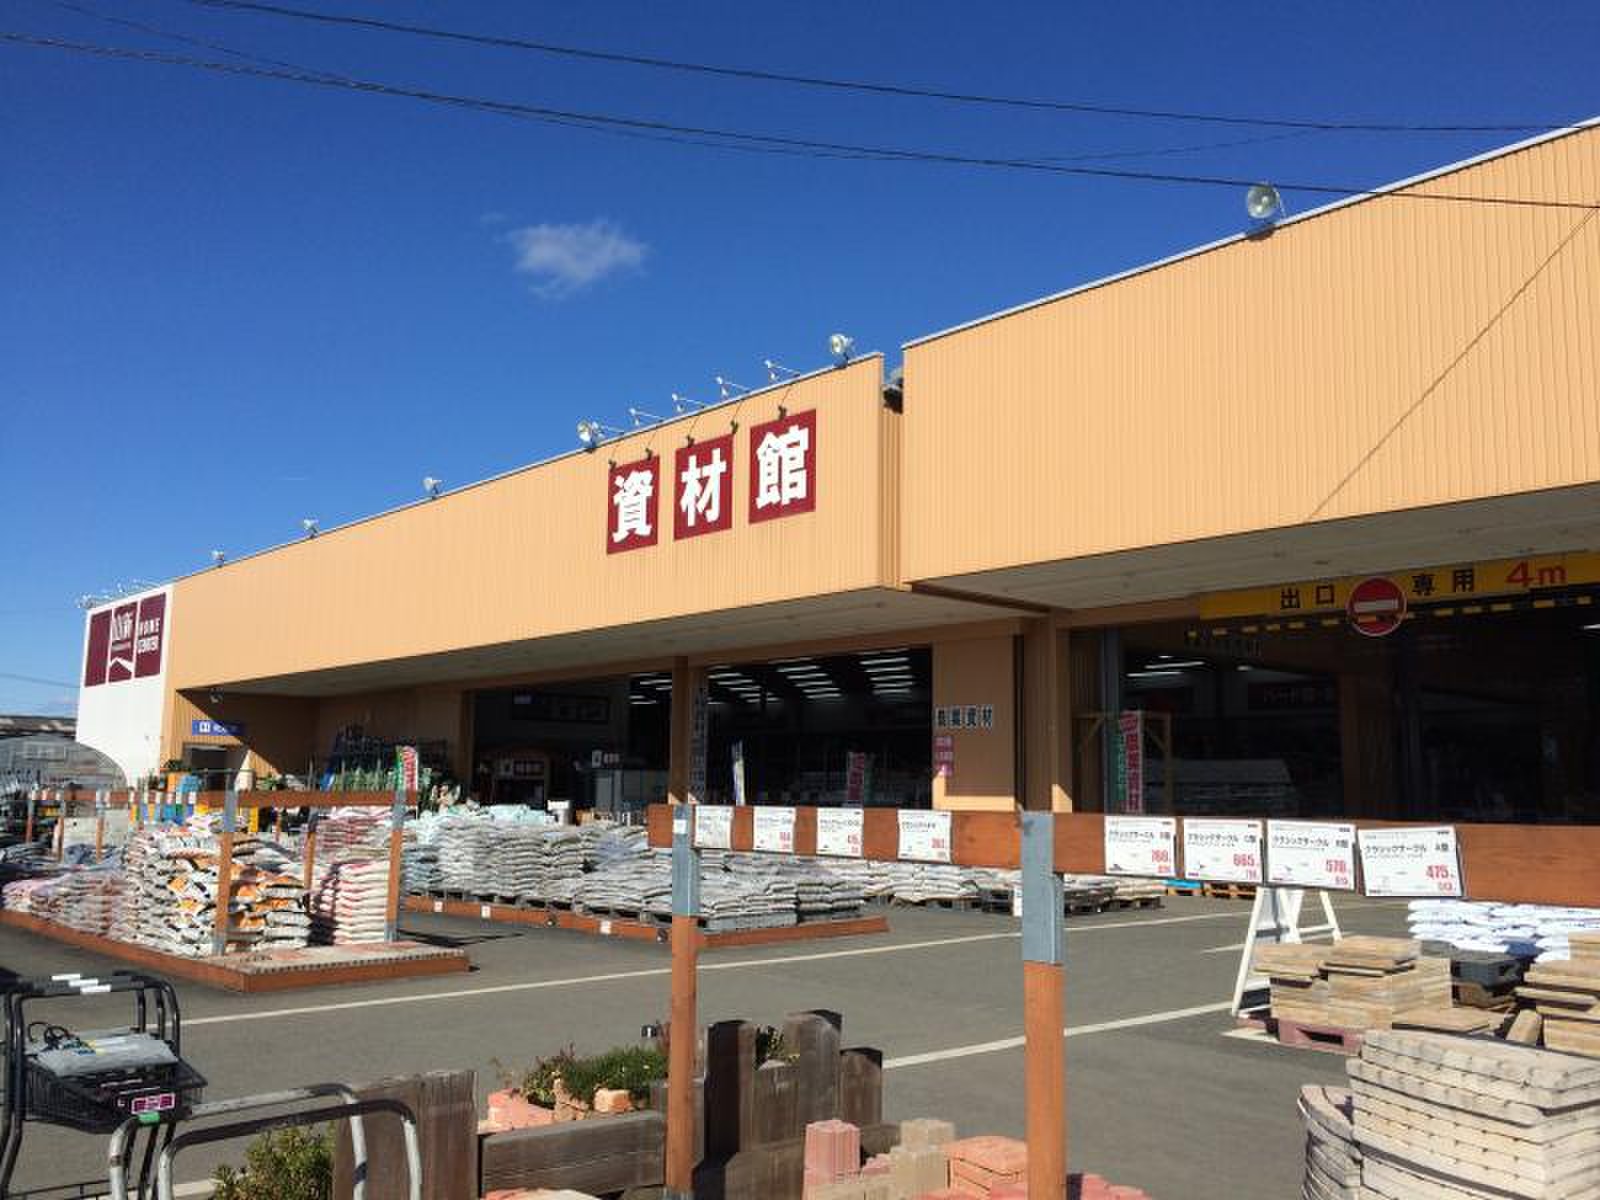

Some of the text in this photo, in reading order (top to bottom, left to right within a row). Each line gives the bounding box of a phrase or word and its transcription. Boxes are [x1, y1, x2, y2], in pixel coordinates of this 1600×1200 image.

[612, 425, 810, 543] 資材館
[1279, 559, 1567, 611] 出口 専用 4m
[1425, 864, 1449, 880] 475
